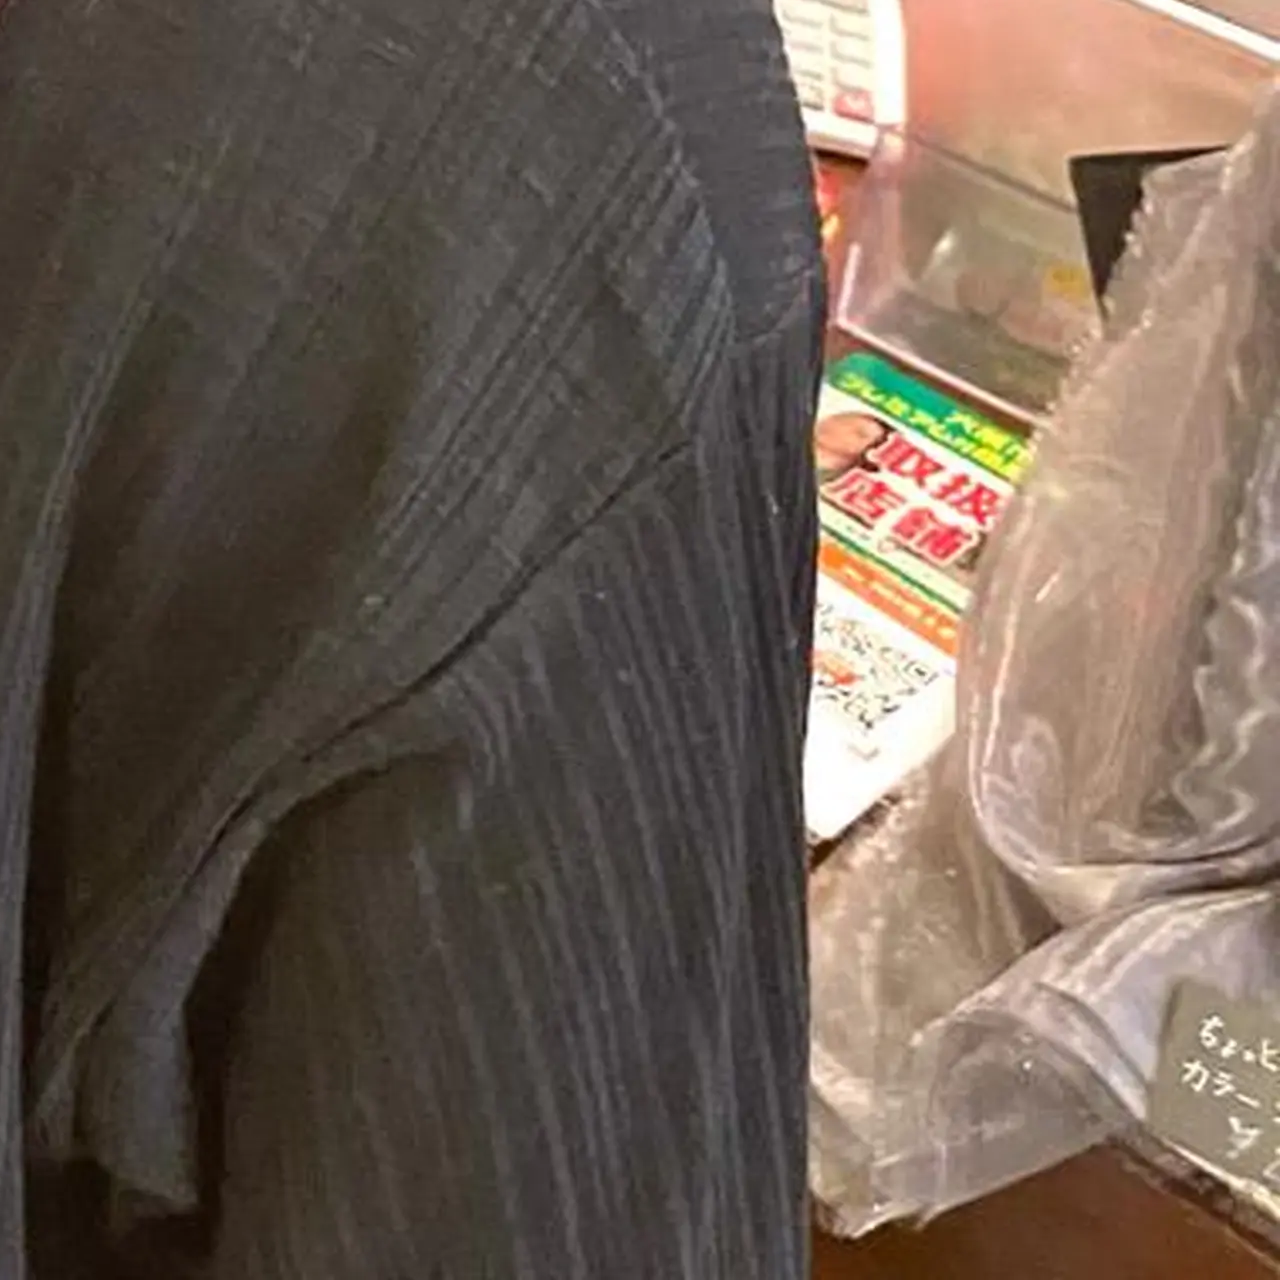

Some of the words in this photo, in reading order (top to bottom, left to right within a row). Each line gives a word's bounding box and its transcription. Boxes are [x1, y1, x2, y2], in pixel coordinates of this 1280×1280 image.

[830, 472, 975, 561] 店舗
[874, 433, 1001, 525] 取扱
[1181, 1060, 1280, 1125] カラー
